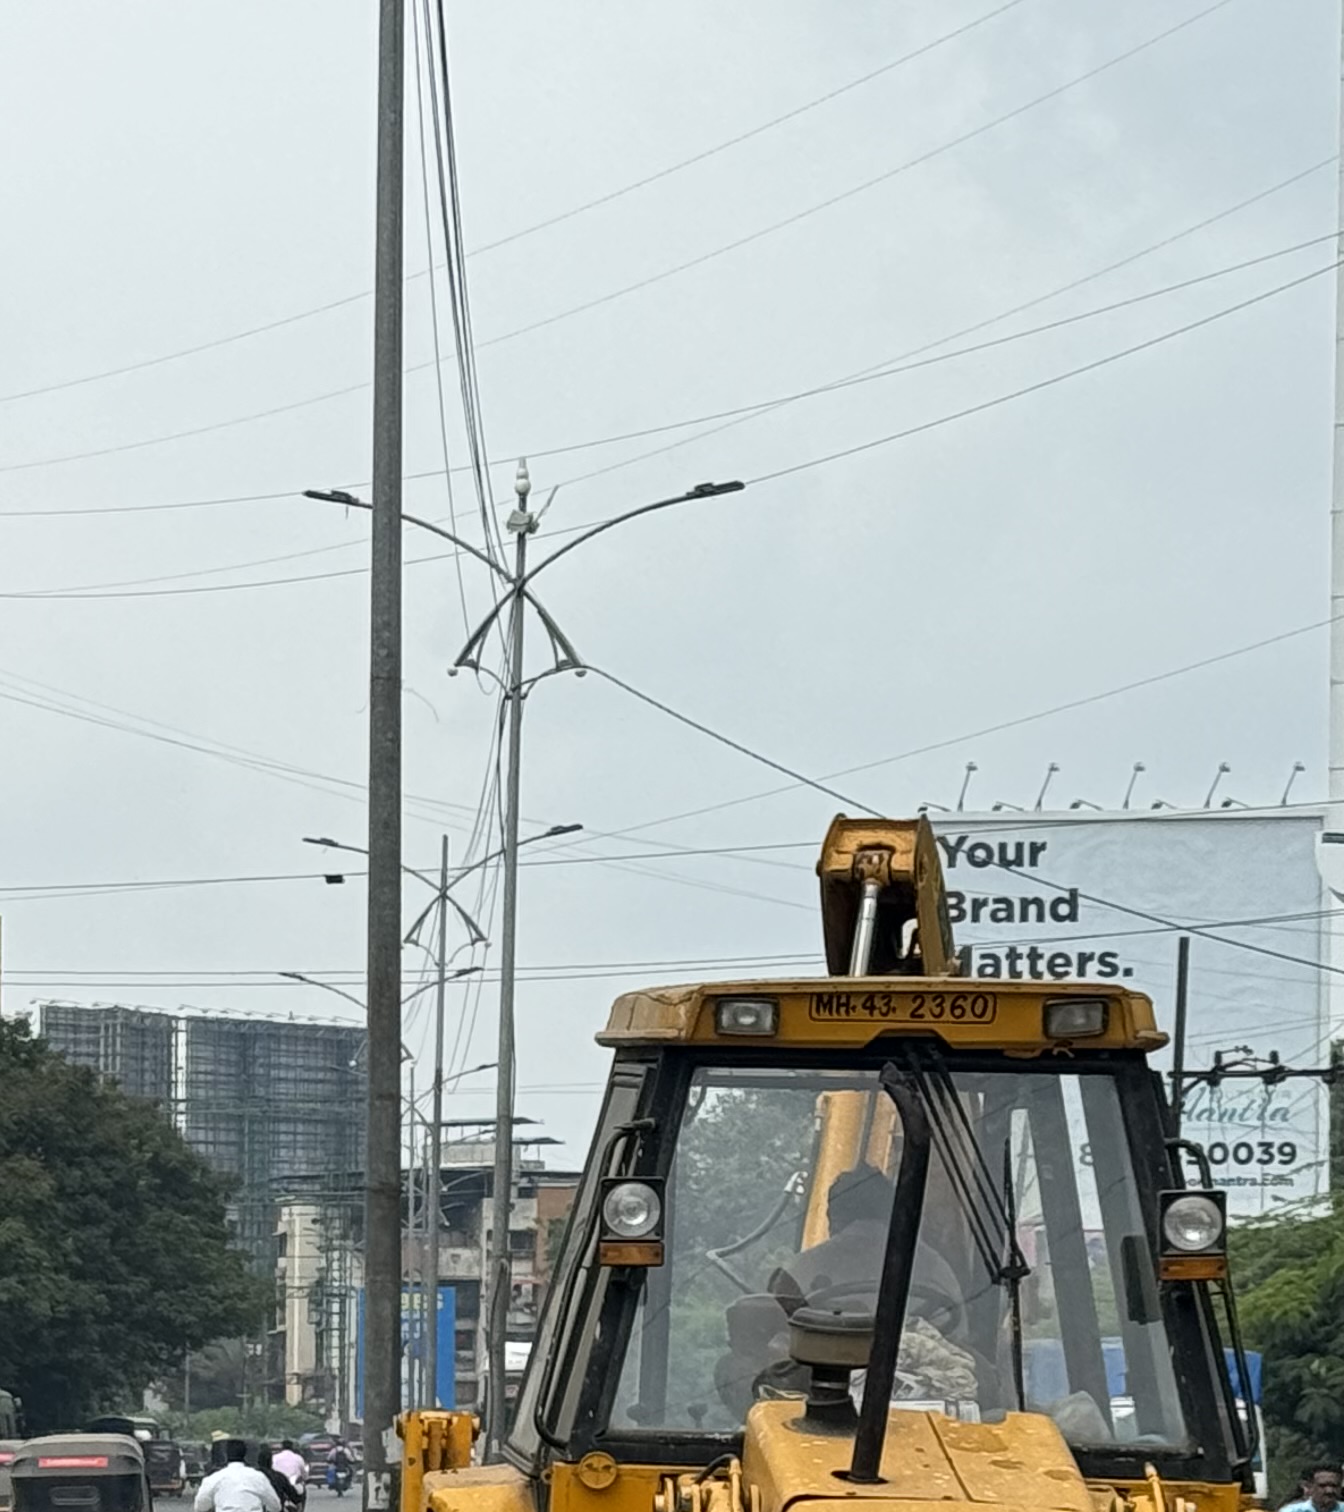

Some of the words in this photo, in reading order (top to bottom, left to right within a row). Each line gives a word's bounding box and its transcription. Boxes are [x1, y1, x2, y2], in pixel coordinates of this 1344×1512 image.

[937, 835, 1047, 868] Your
[945, 888, 1079, 923] Brand
[910, 993, 989, 1019] 2360
